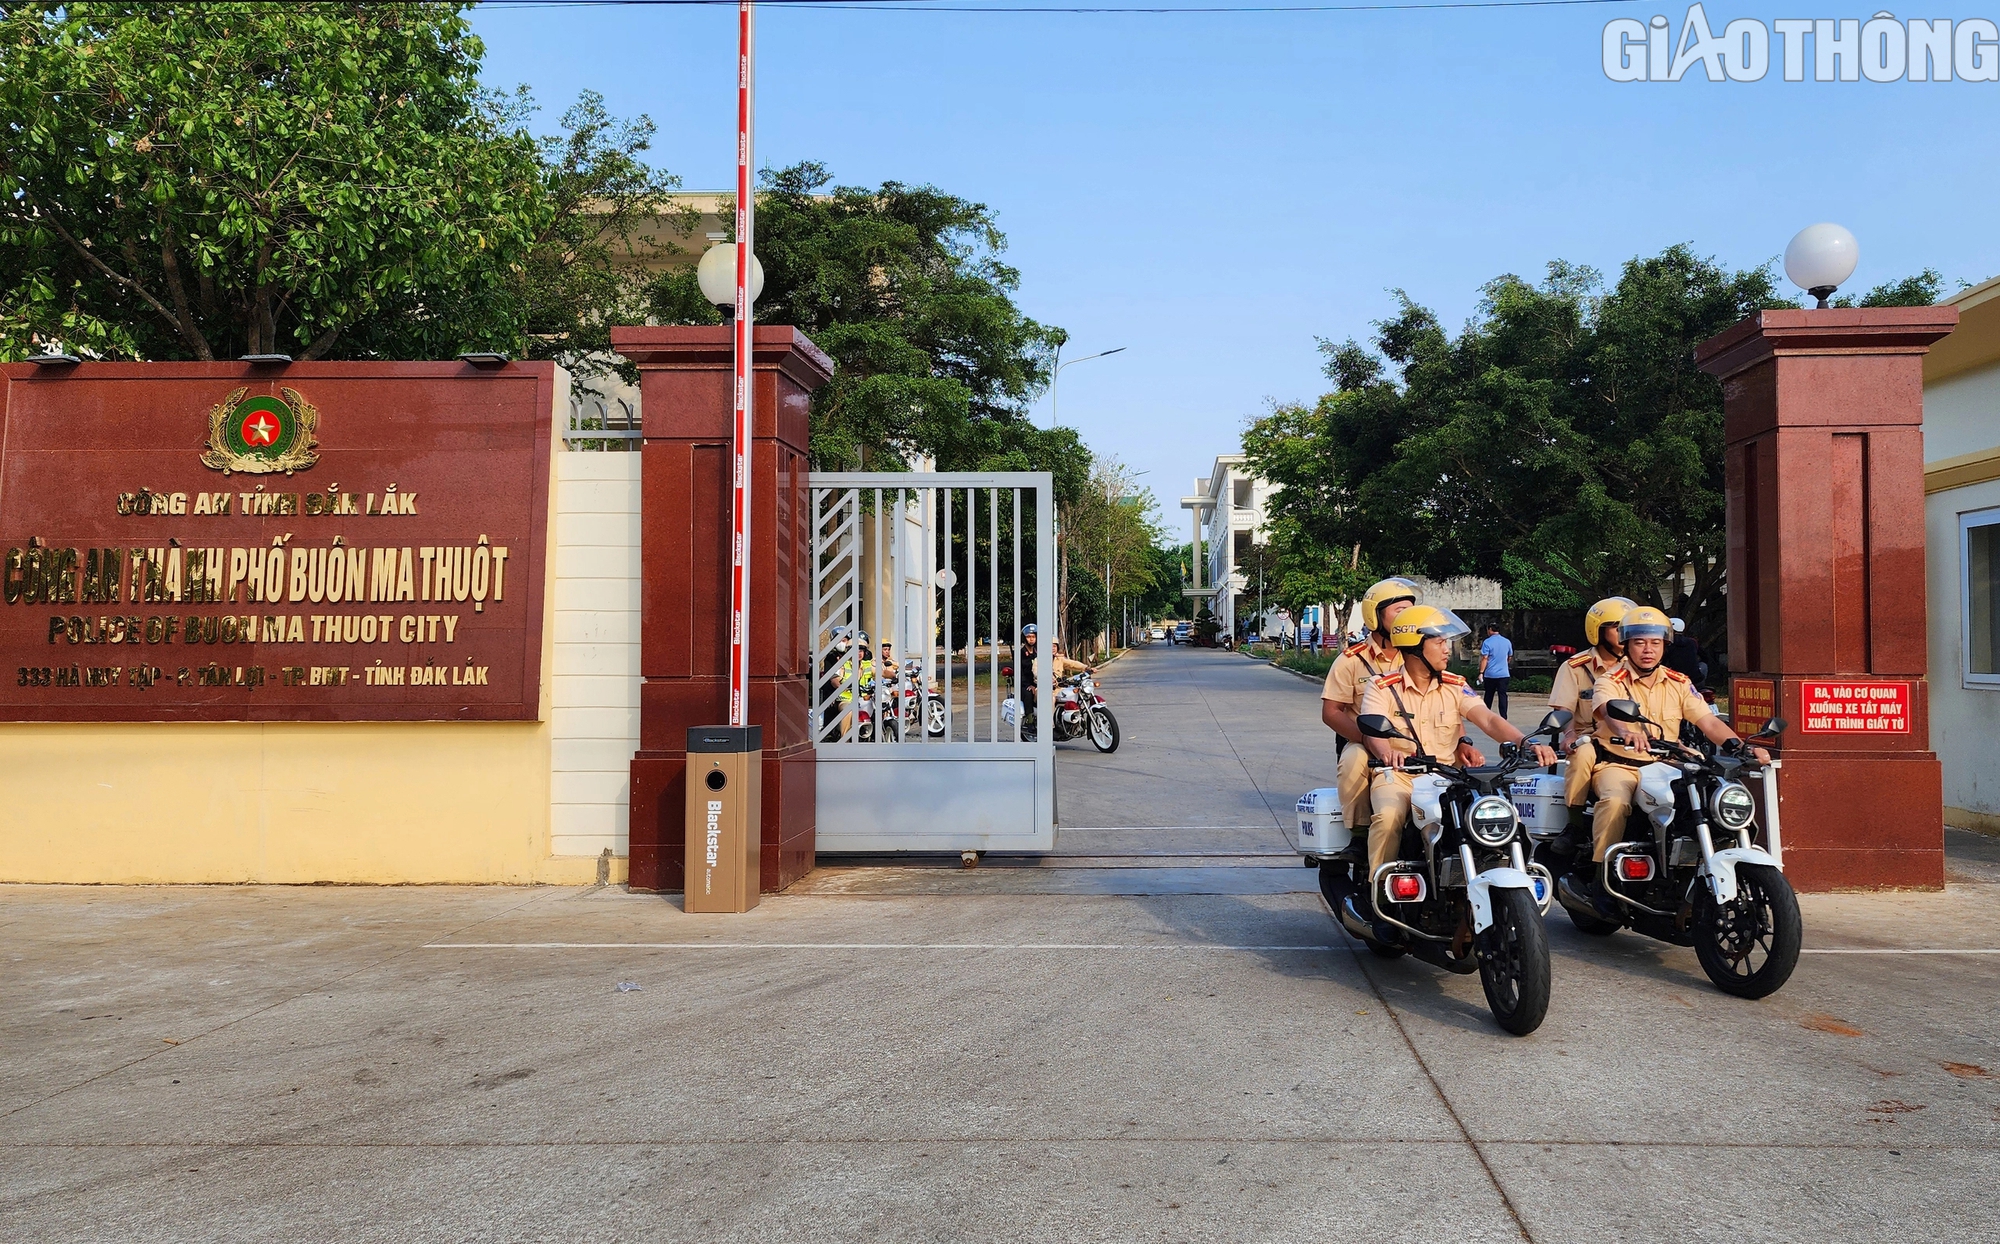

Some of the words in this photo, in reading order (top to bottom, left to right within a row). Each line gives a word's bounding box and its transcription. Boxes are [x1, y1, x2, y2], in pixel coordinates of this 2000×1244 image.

[117, 486, 187, 516] CÔNG
[194, 492, 232, 516] AN
[239, 484, 299, 516] TỈNH
[305, 482, 360, 516] ĐẮK
[366, 482, 418, 516] LẮK
[4, 536, 80, 603] CÔNG
[81, 548, 123, 603] AN
[130, 537, 224, 603] THÀNH
[229, 533, 293, 604] PHỐ
[289, 535, 367, 604] BUÔN
[370, 547, 415, 603] MA
[419, 534, 508, 613] THUỘT
[49, 615, 142, 644] POLICE
[146, 615, 180, 643] OF
[184, 615, 257, 643] BUON
[261, 615, 305, 643] MA
[310, 615, 394, 643] THUOT
[400, 615, 459, 643] CITY
[17, 666, 51, 686] 333
[56, 661, 81, 687] HÀ
[85, 666, 122, 686] HUY
[198, 661, 232, 686] TÂN
[364, 658, 405, 686] TỈNH
[410, 656, 448, 686] ĐẮK
[452, 656, 489, 686] LẮK
[1809, 700, 1843, 714] XUỐNG
[1845, 703, 1858, 714] XE
[1860, 700, 1878, 714] TẮT
[1880, 702, 1902, 715] MÁY
[1814, 688, 1831, 699] RA,
[1833, 686, 1852, 698] VÀO
[1854, 686, 1868, 698] CƠ
[1870, 688, 1897, 700] QUAN
[1808, 715, 1832, 729] XUẤT
[1834, 716, 1864, 730] TRÌNH
[1866, 715, 1890, 730] GIẤY
[1892, 717, 1904, 730] TỜ
[706, 800, 722, 867] Blackstar
